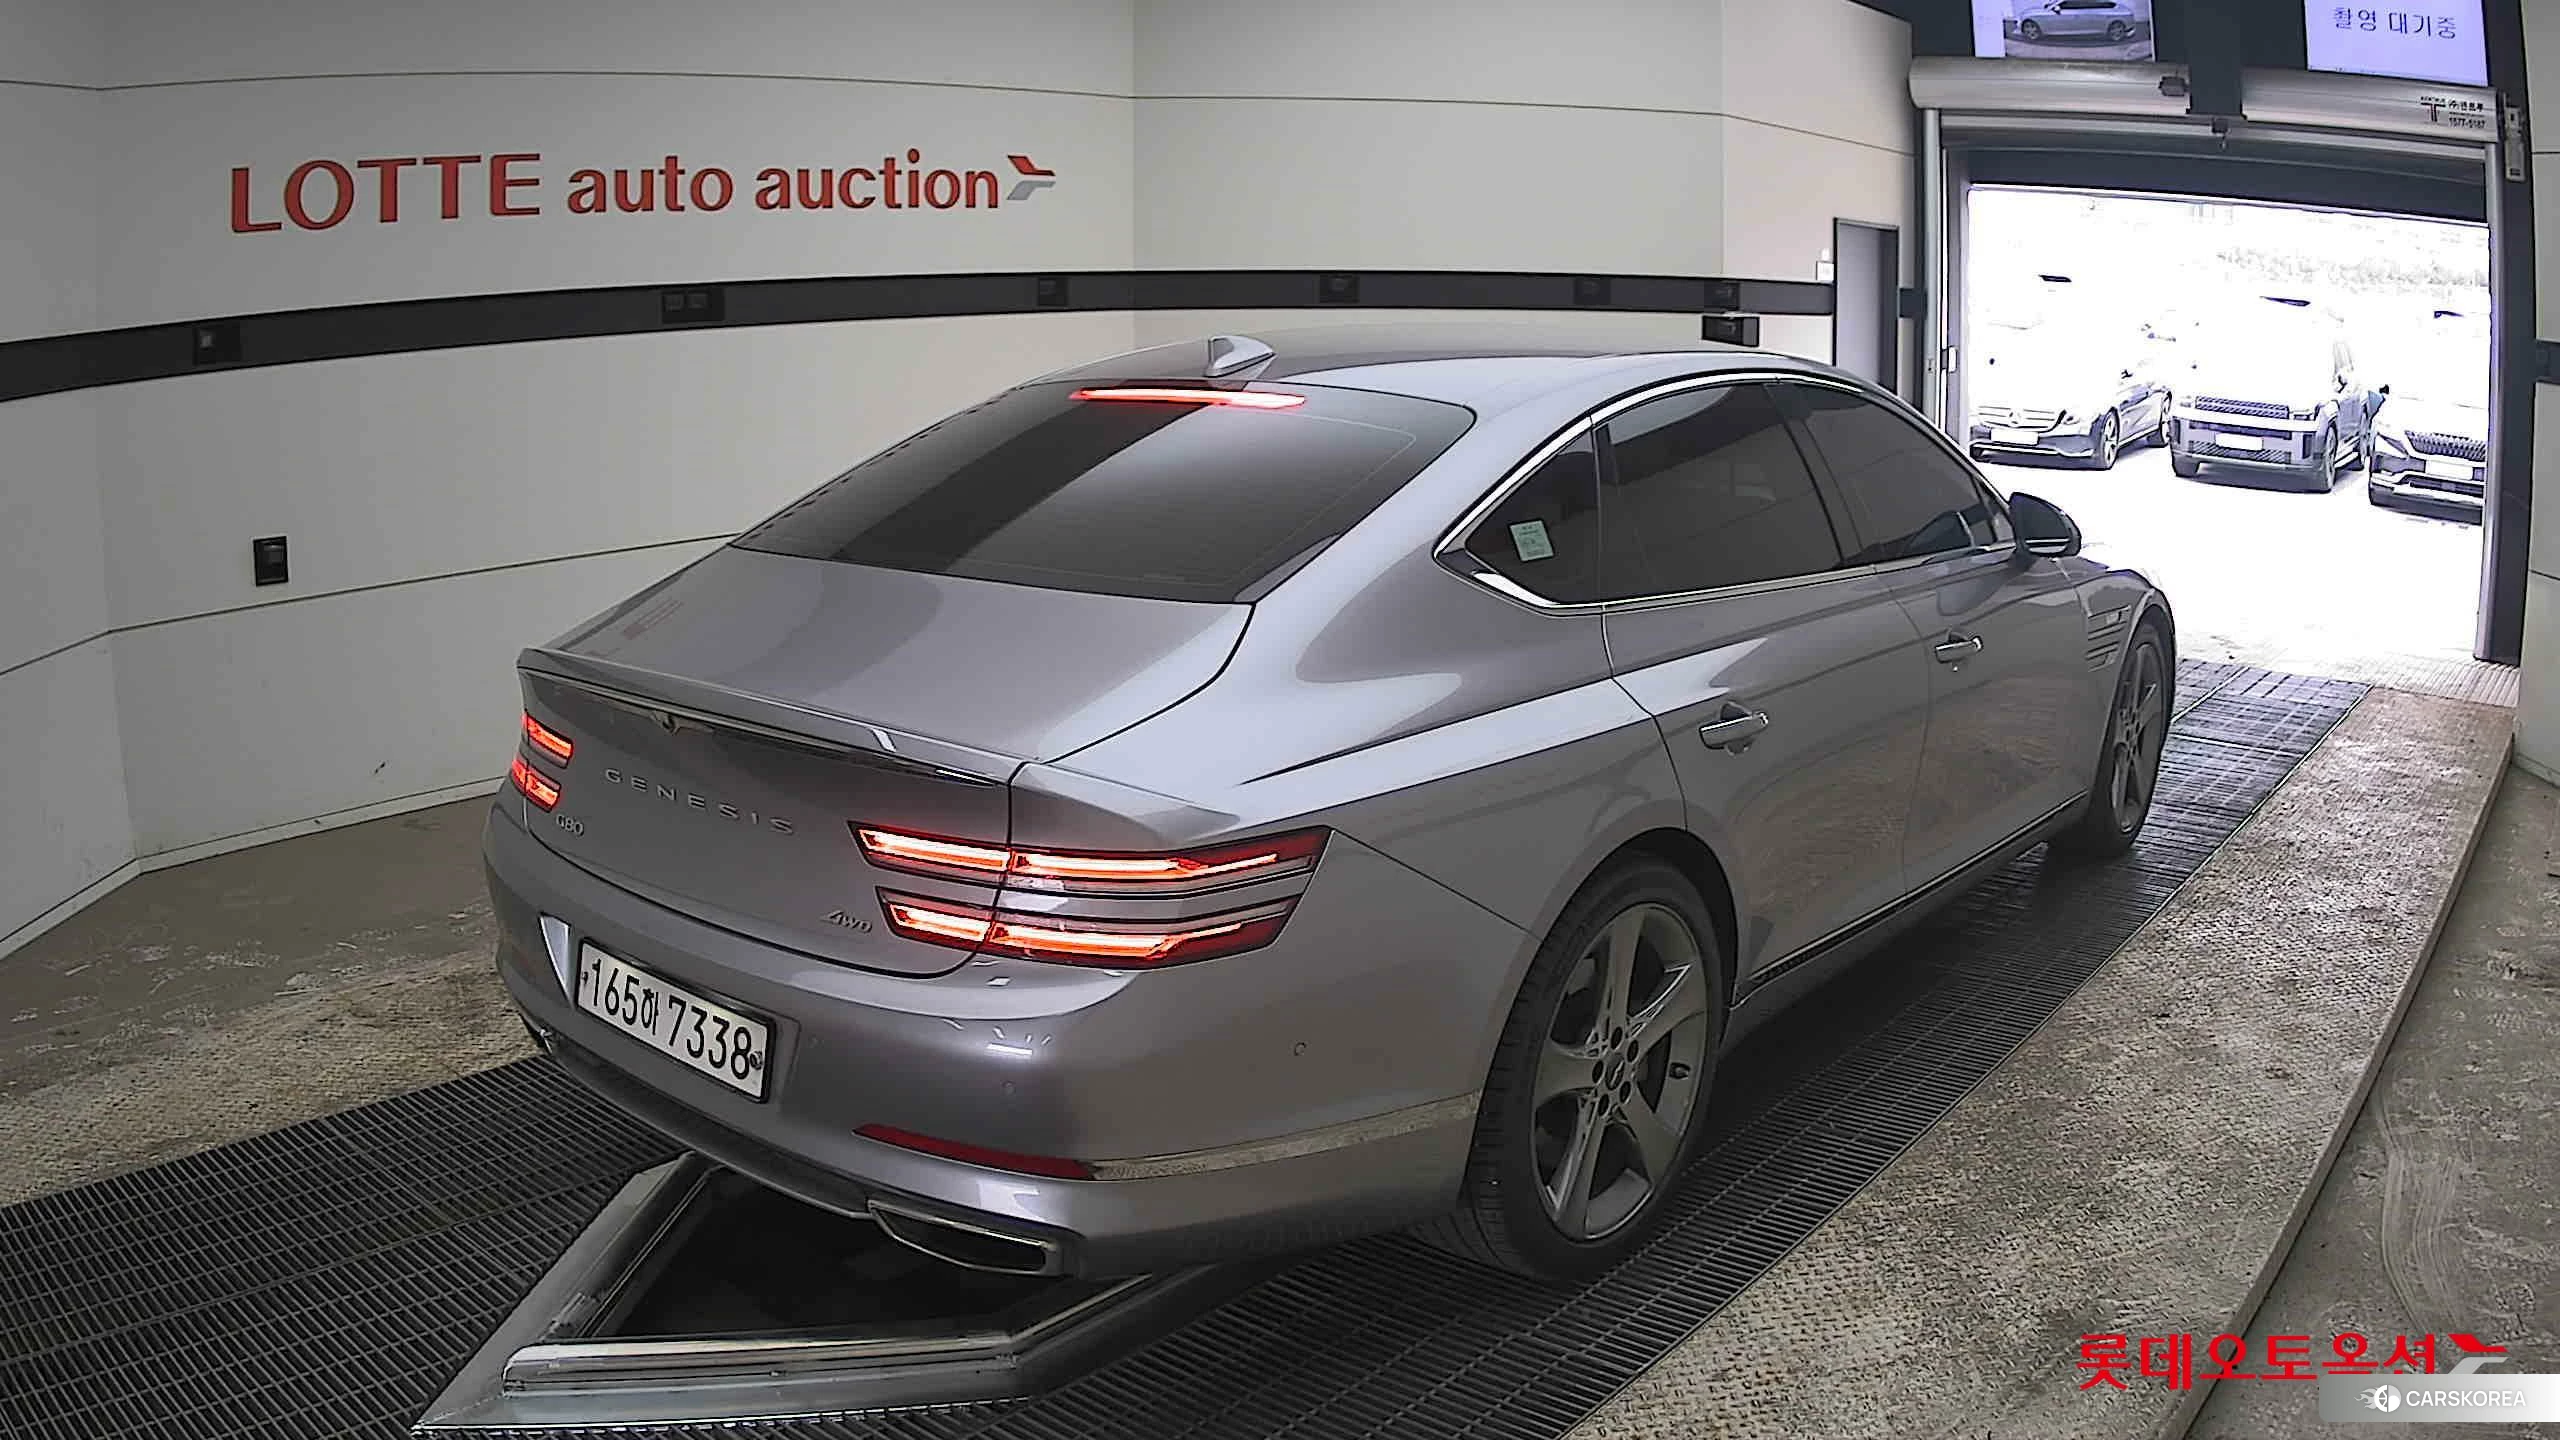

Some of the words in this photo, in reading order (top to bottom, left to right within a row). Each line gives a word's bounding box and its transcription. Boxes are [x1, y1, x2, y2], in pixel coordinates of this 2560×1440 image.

[2388, 11, 2457, 40] 대기중
[231, 152, 541, 234] LOTTE
[567, 154, 734, 214] auto
[754, 148, 1002, 210] auction
[556, 813, 585, 838] G80
[604, 767, 795, 835] GENESIS
[591, 958, 661, 1036] 165하
[668, 994, 753, 1080] 7338
